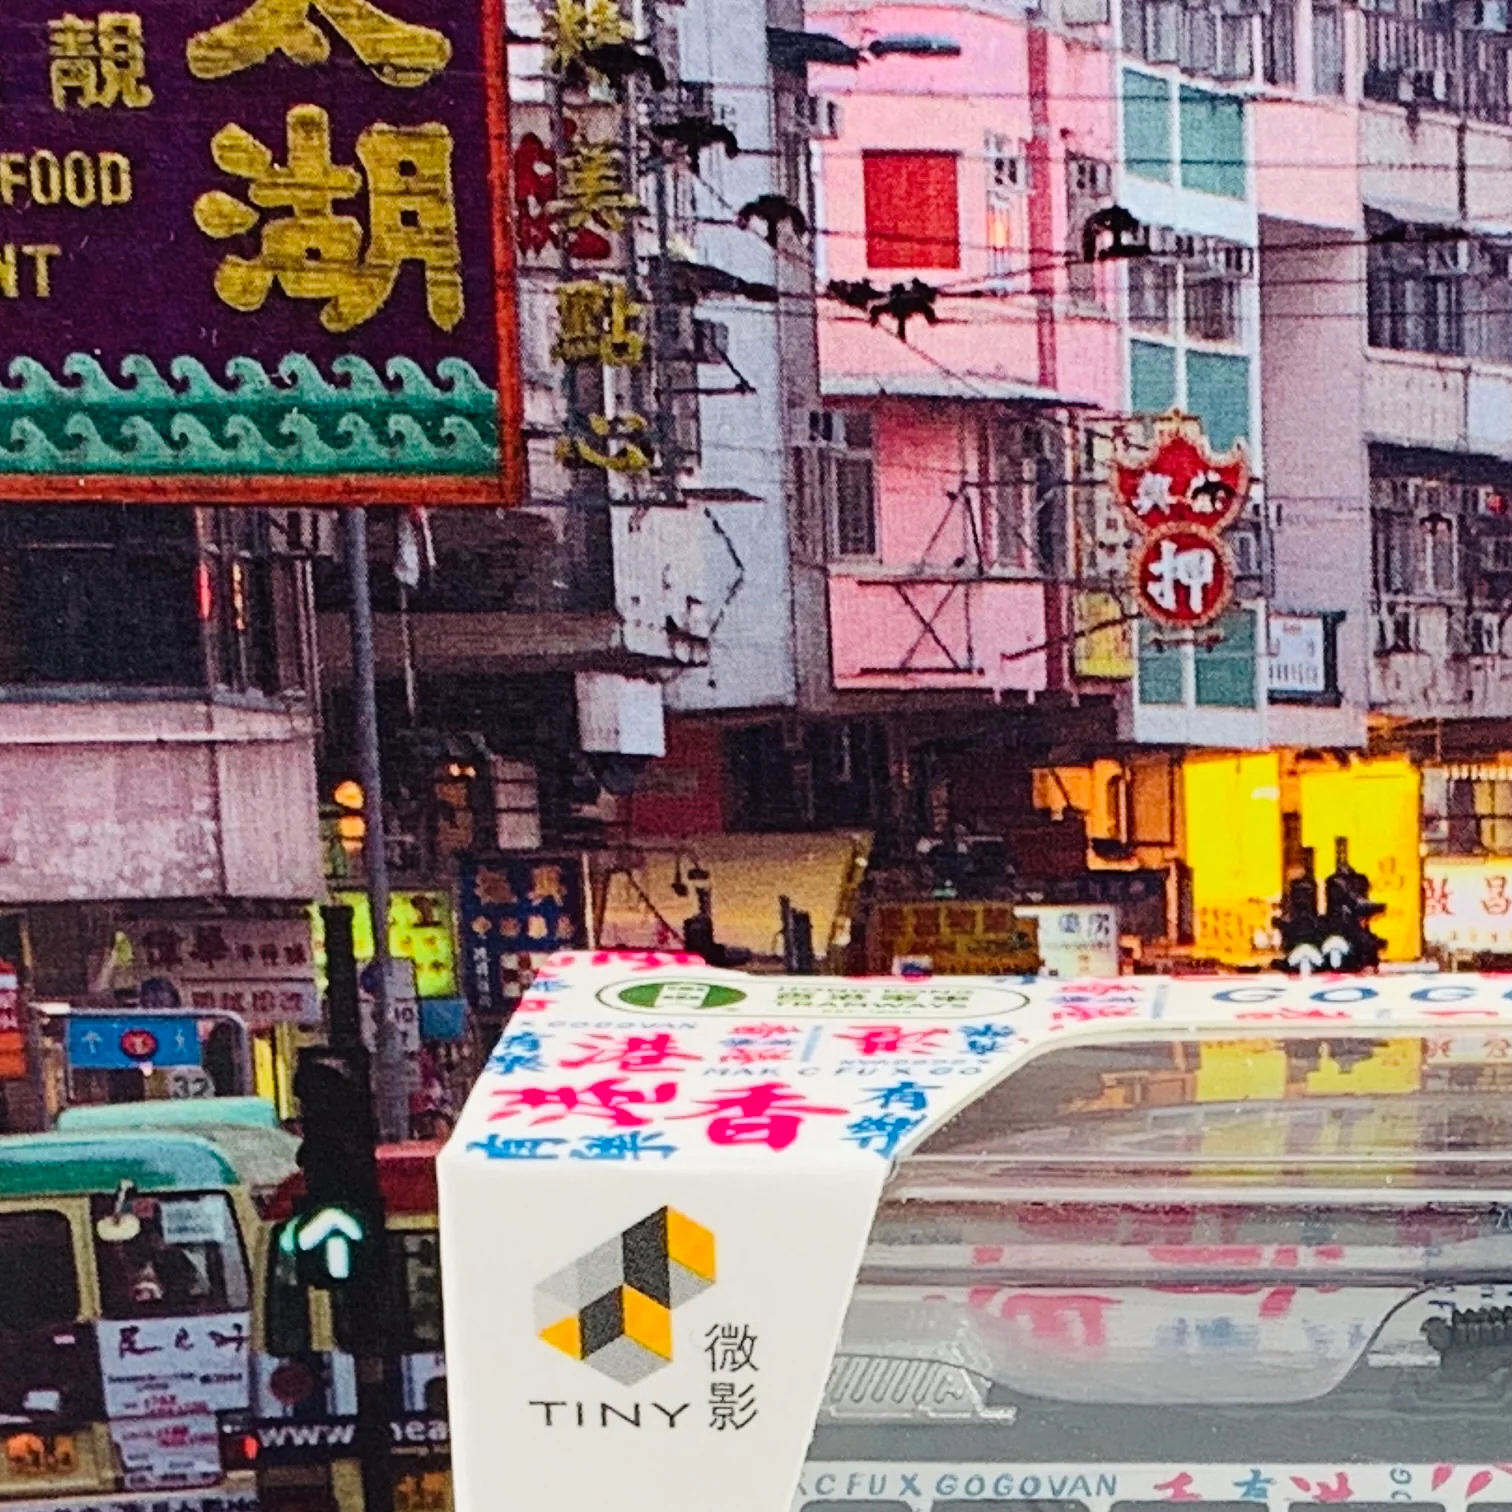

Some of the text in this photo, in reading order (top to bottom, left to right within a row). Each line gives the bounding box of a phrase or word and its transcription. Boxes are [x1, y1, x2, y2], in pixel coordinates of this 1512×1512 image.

[47, 11, 154, 112] 靚
[704, 1321, 760, 1433] 微影
[529, 1400, 690, 1429] TINY
[846, 1474, 887, 1497] FU
[899, 1474, 923, 1497] X
[934, 1473, 1118, 1498] GOGOVAN
